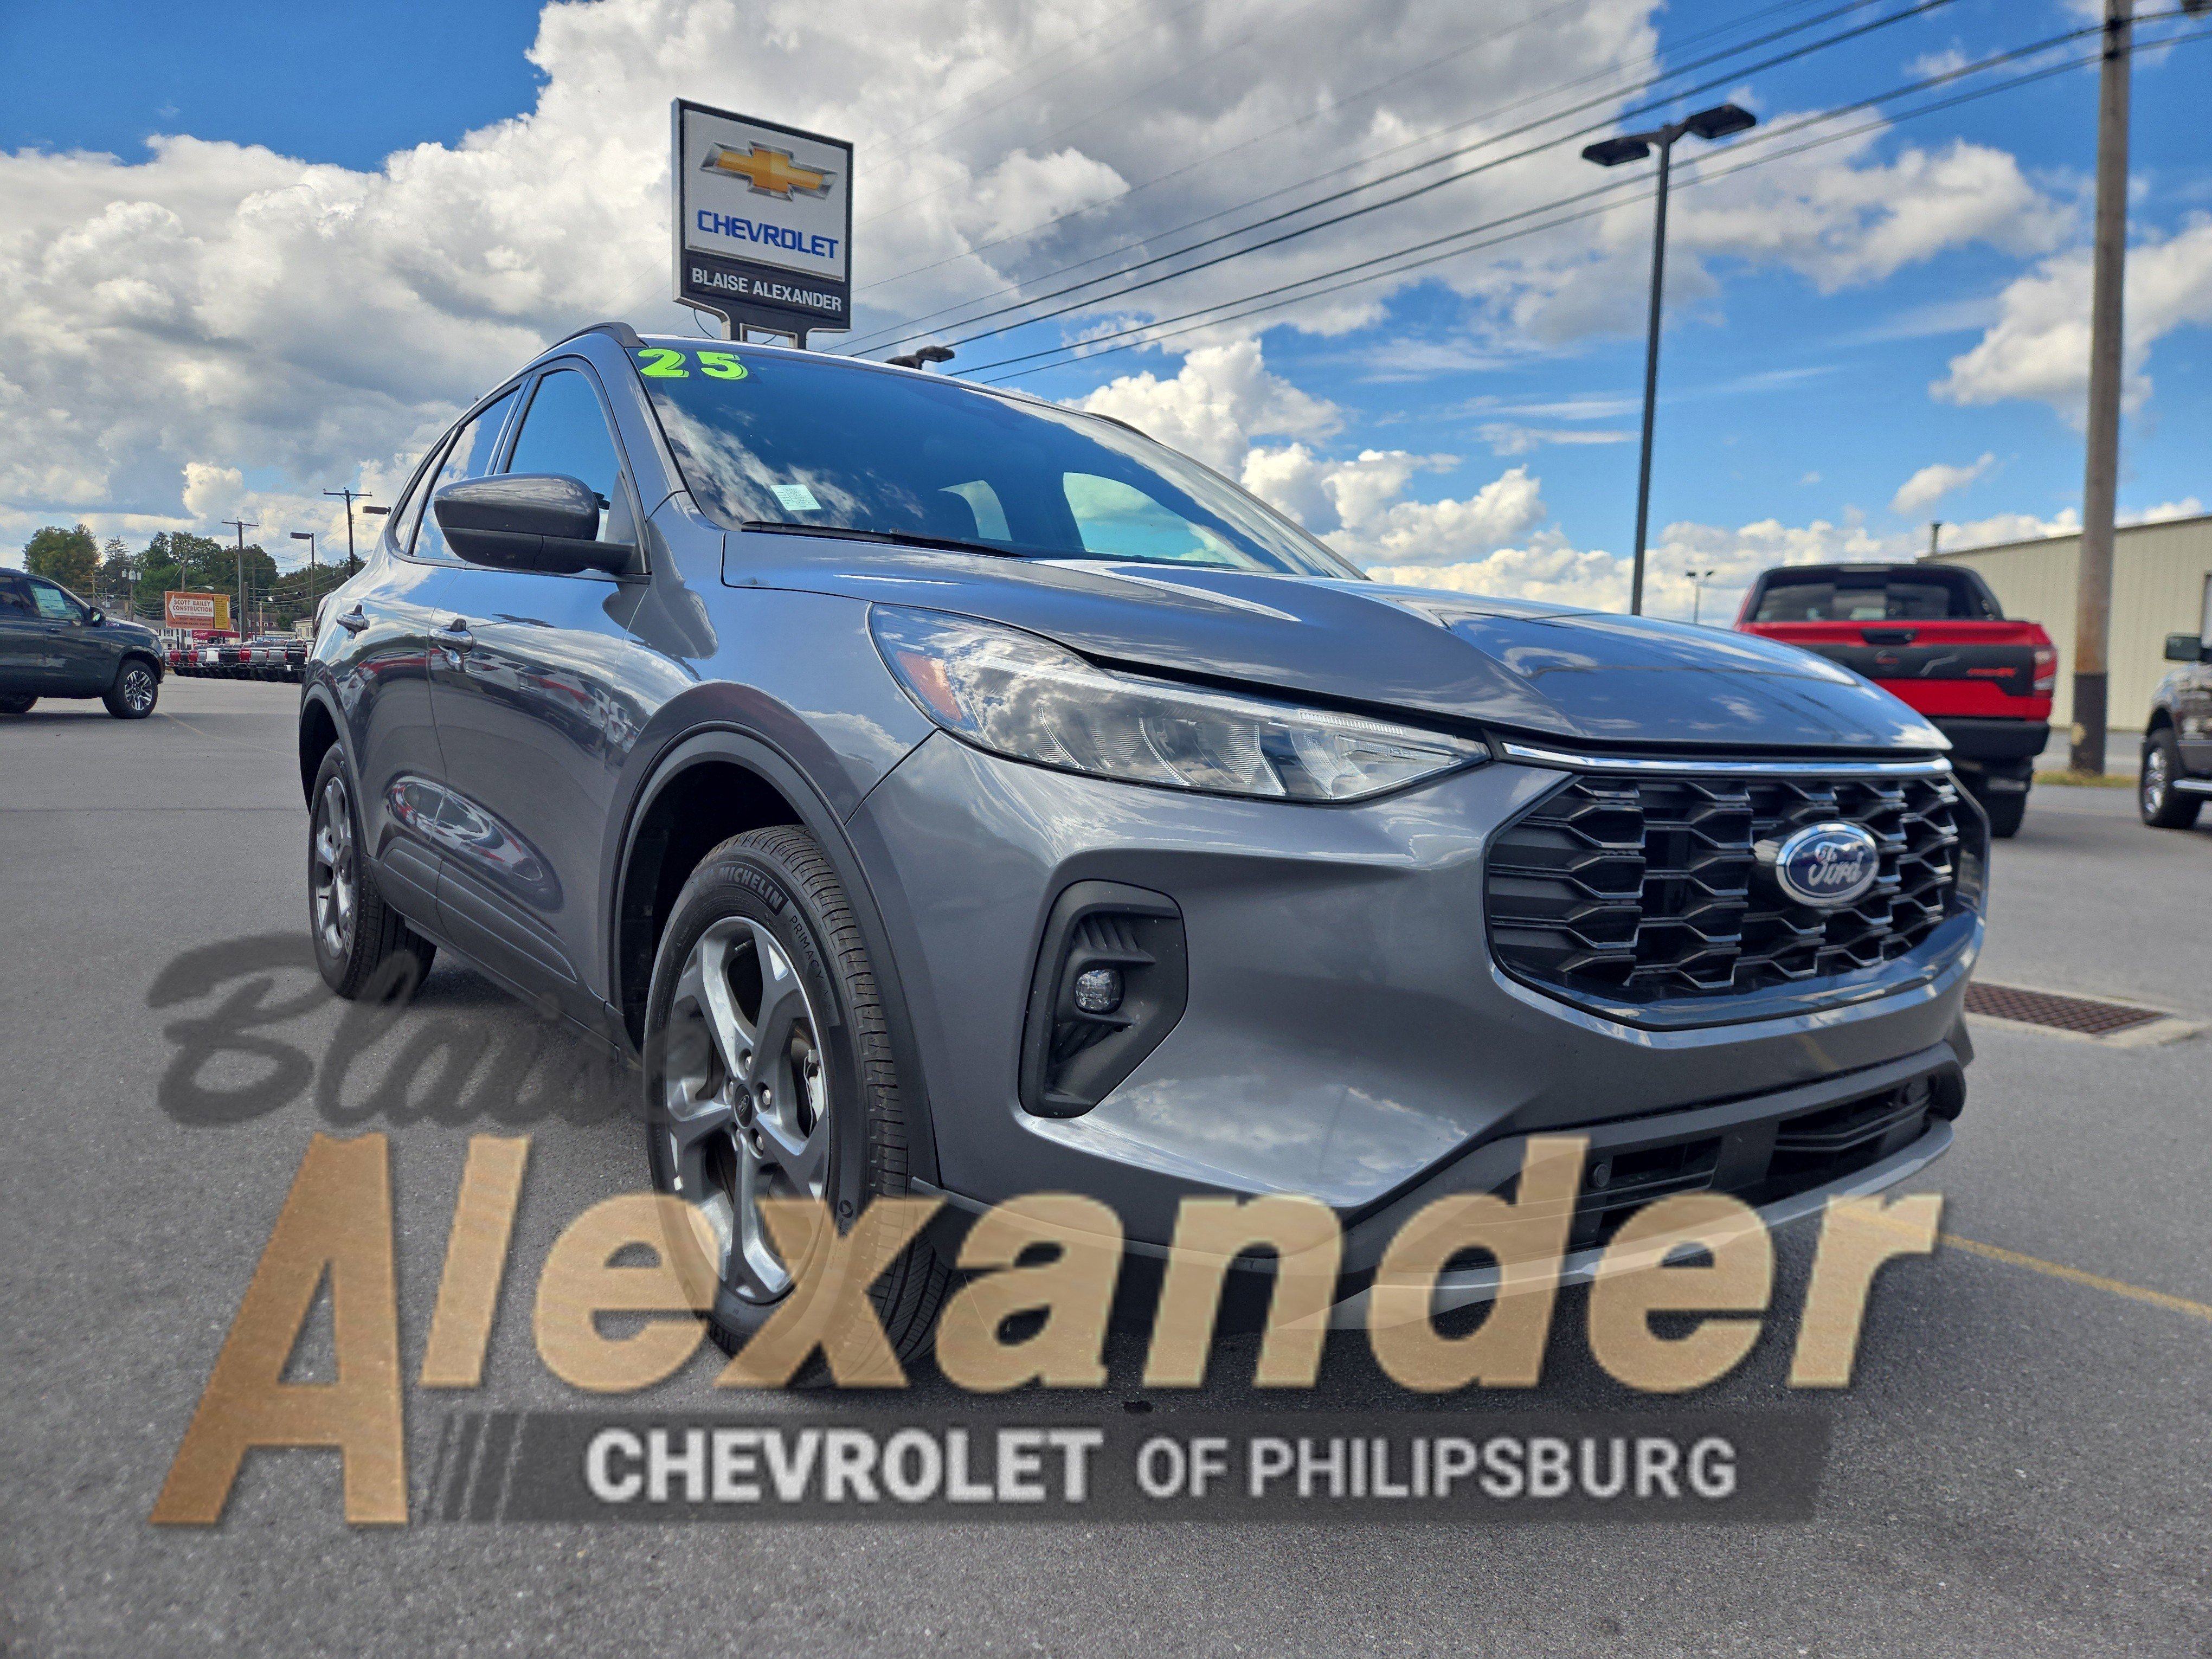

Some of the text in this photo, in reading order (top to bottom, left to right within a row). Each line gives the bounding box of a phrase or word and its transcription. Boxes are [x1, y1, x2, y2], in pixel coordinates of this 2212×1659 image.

[697, 209, 839, 259] CHEVROLET
[692, 267, 842, 312] BLAISE ALEXANDER
[637, 349, 748, 380] 25
[1808, 841, 1864, 887] Ford
[719, 866, 783, 910] MICHELIN
[789, 915, 825, 980] PRIMACY
